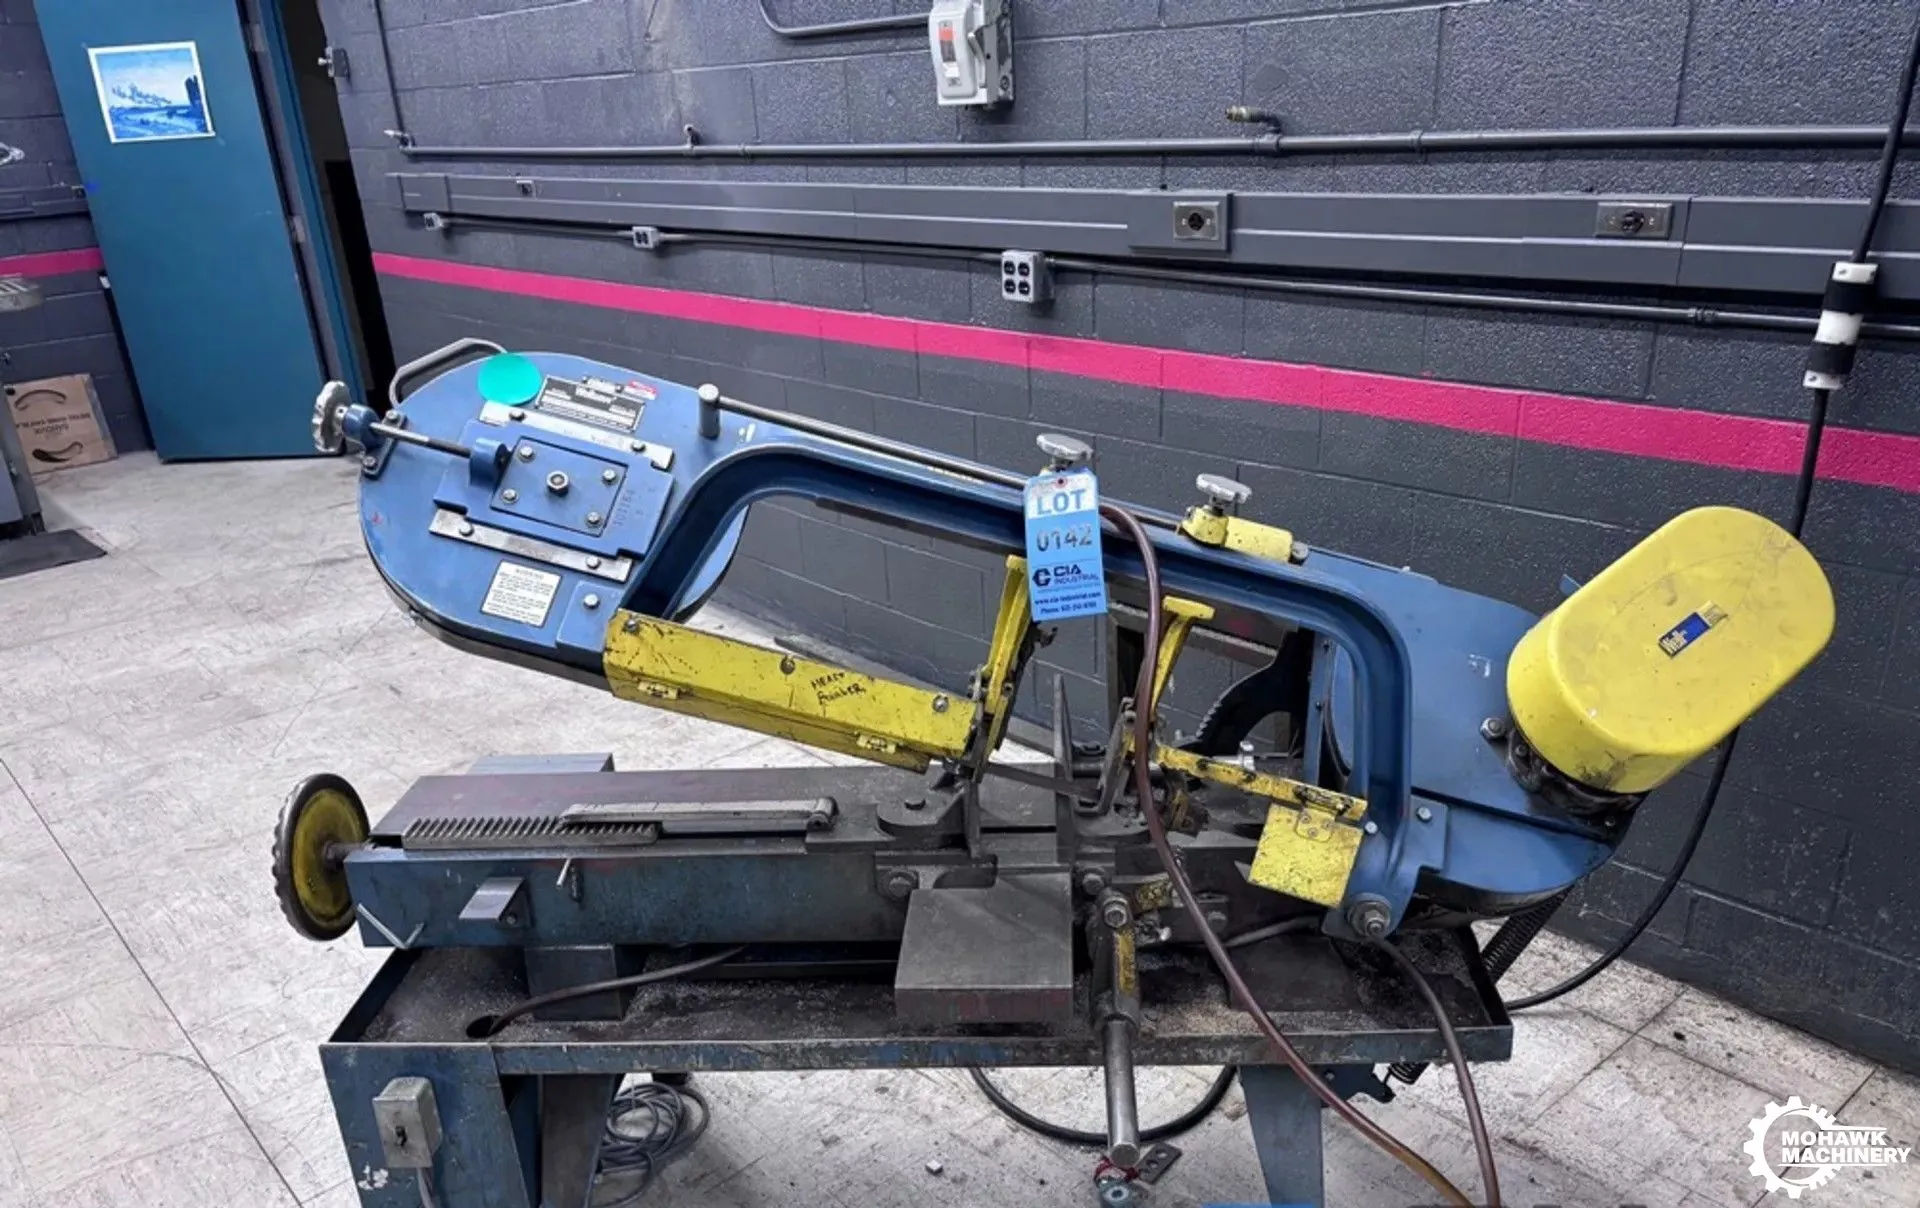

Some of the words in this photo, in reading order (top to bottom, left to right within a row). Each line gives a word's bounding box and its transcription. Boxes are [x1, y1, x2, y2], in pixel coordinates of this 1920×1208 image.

[1037, 488, 1086, 515] LOT
[1053, 564, 1082, 577] CIA
[1054, 573, 1099, 585] INDUSTRIAL
